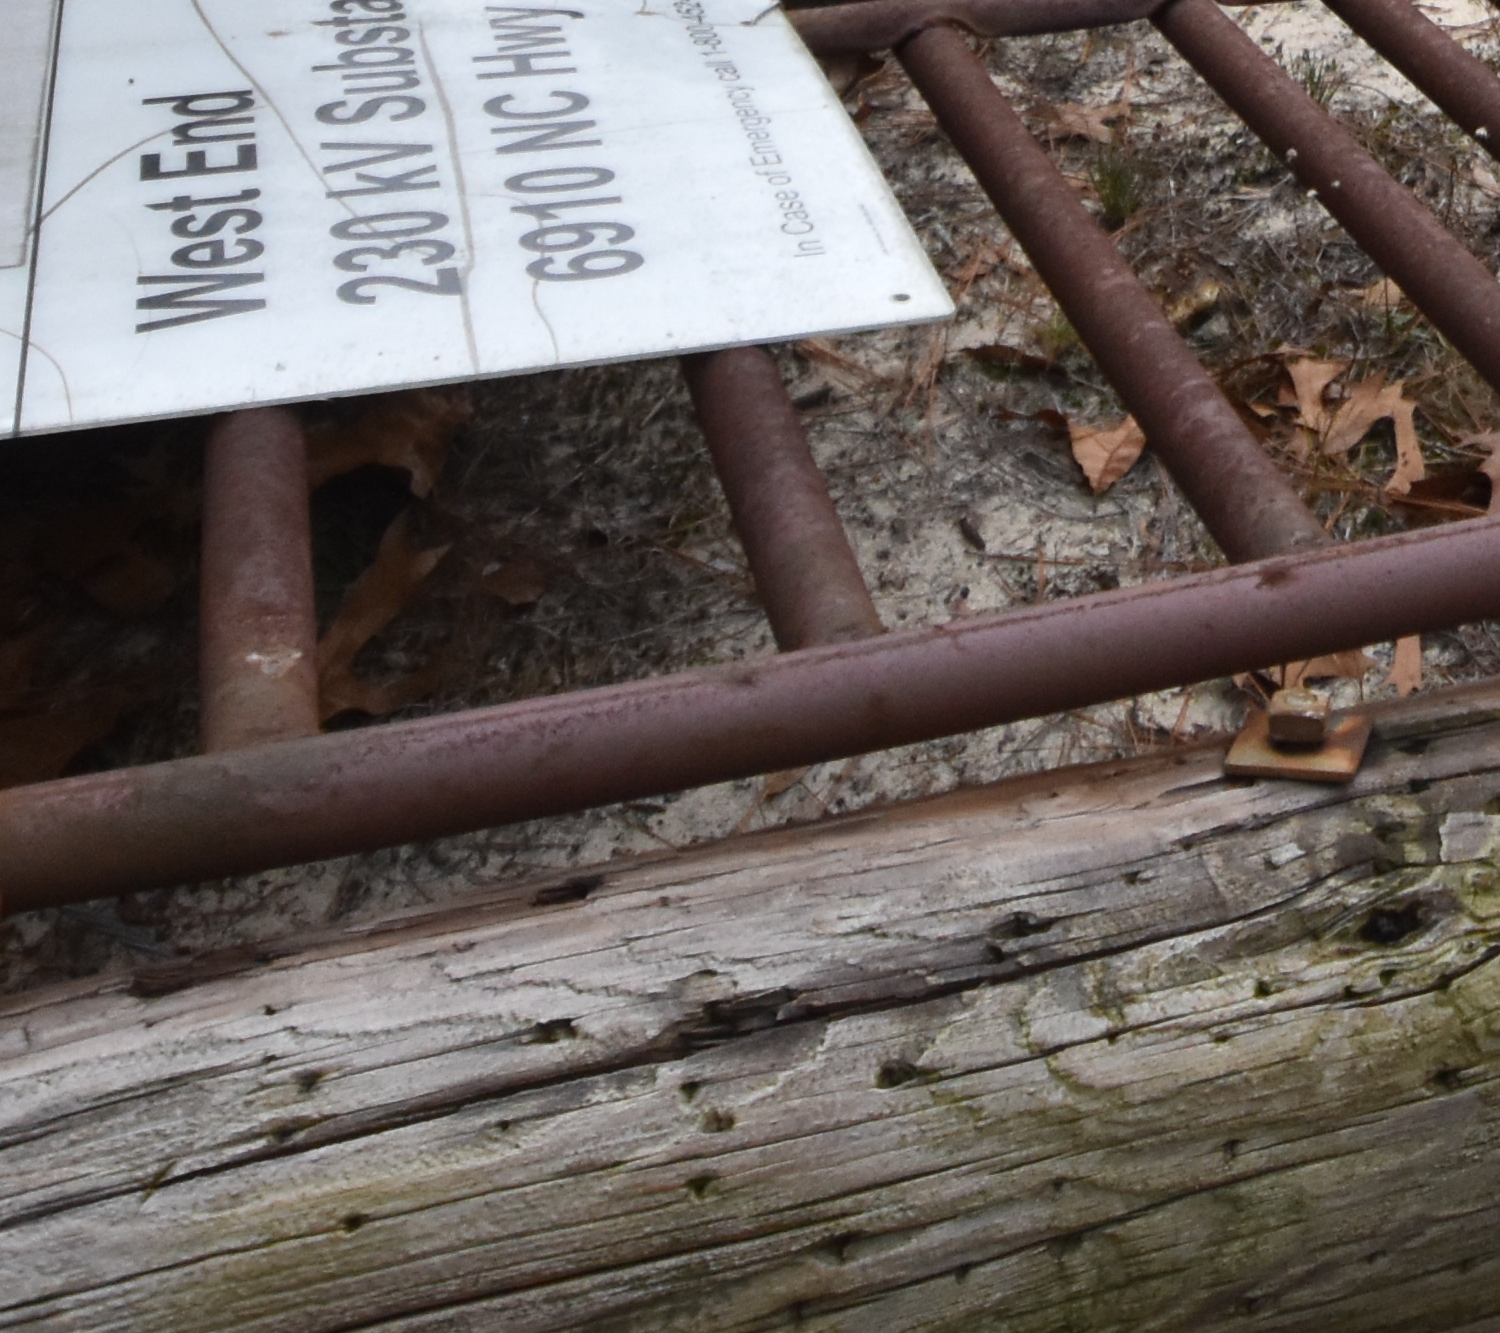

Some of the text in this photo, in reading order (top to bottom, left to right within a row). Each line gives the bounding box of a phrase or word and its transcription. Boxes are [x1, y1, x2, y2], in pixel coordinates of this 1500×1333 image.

[472, 6, 585, 80] Hwy
[704, 60, 741, 81] call
[483, 90, 602, 155] NC
[727, 85, 782, 167] Emergency
[319, 141, 440, 199] kV
[755, 171, 791, 185] of
[135, 89, 266, 333] West End
[503, 166, 644, 282] 6910
[775, 190, 814, 235] Case
[329, 210, 465, 305] 230
[794, 239, 826, 258] In
